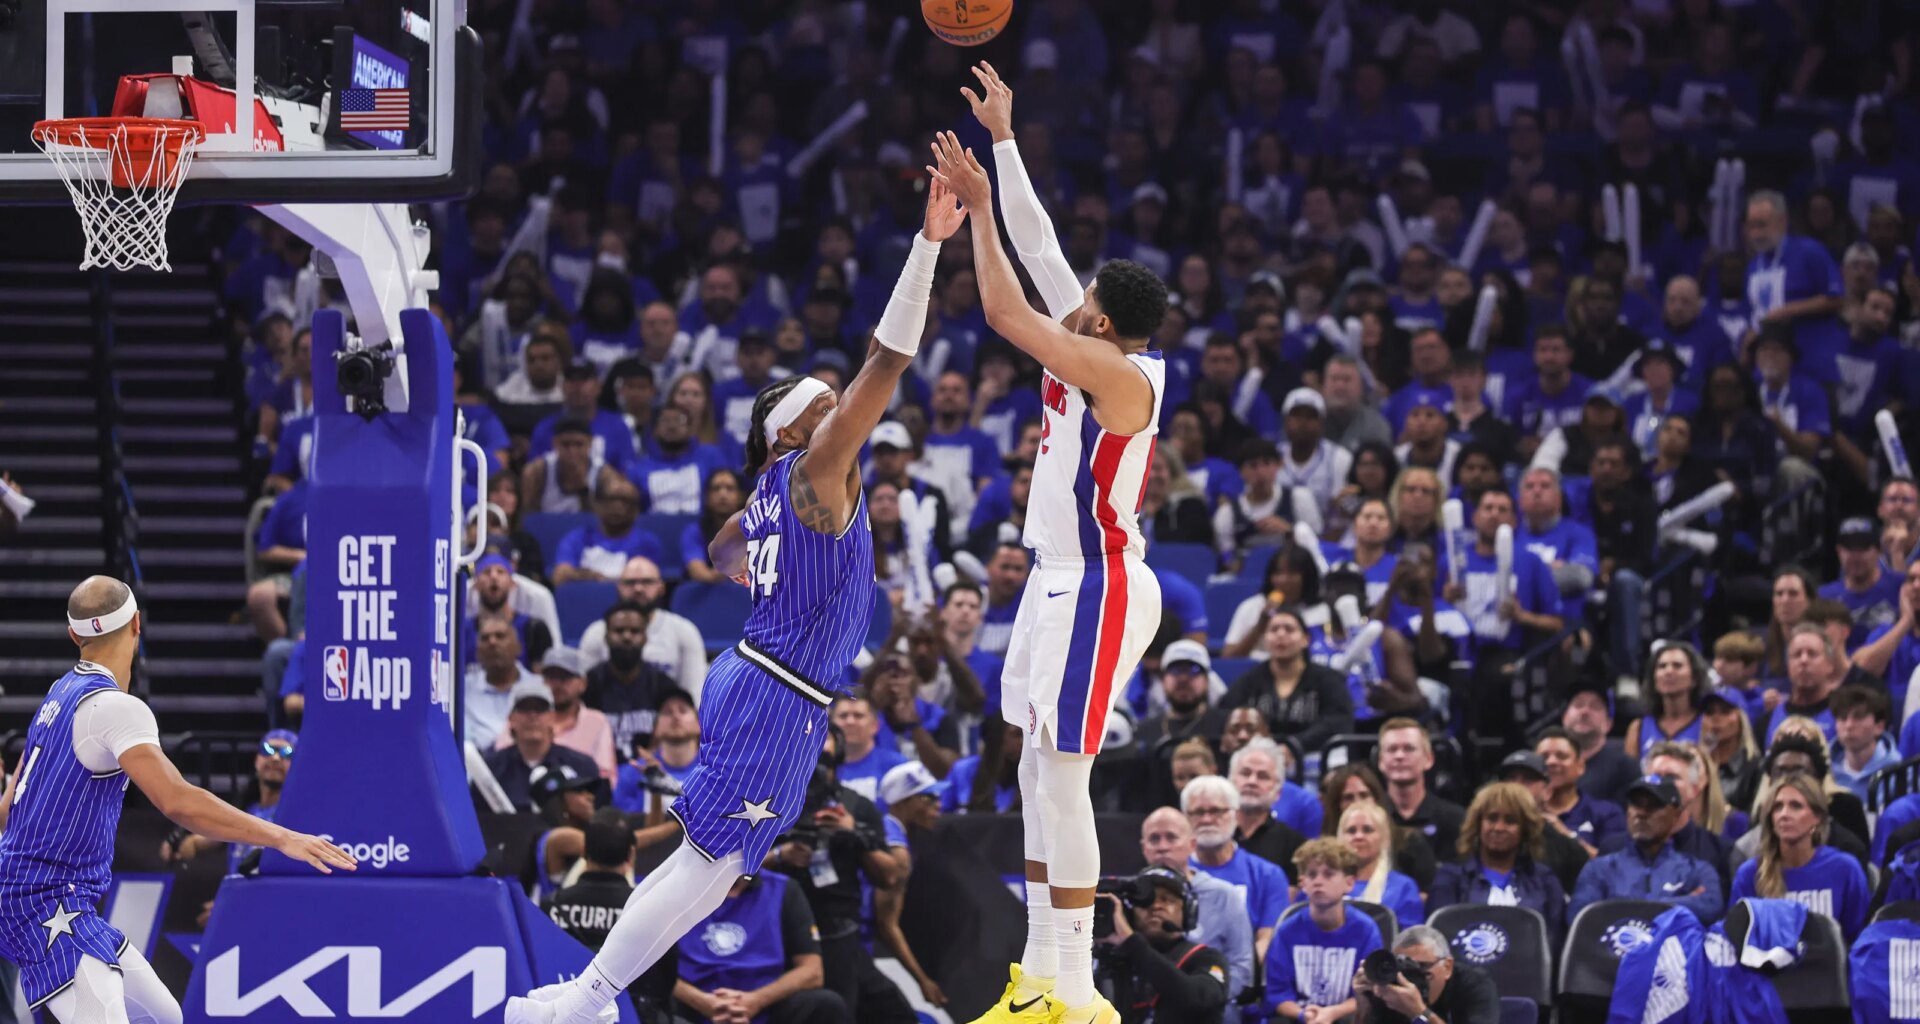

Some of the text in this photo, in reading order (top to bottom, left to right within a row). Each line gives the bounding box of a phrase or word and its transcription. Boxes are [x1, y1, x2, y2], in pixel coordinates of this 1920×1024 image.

[338, 535, 397, 587] GET
[337, 590, 398, 641] THE
[351, 646, 412, 710] App
[549, 904, 623, 930] SECURIT
[205, 945, 507, 1019] KIA
